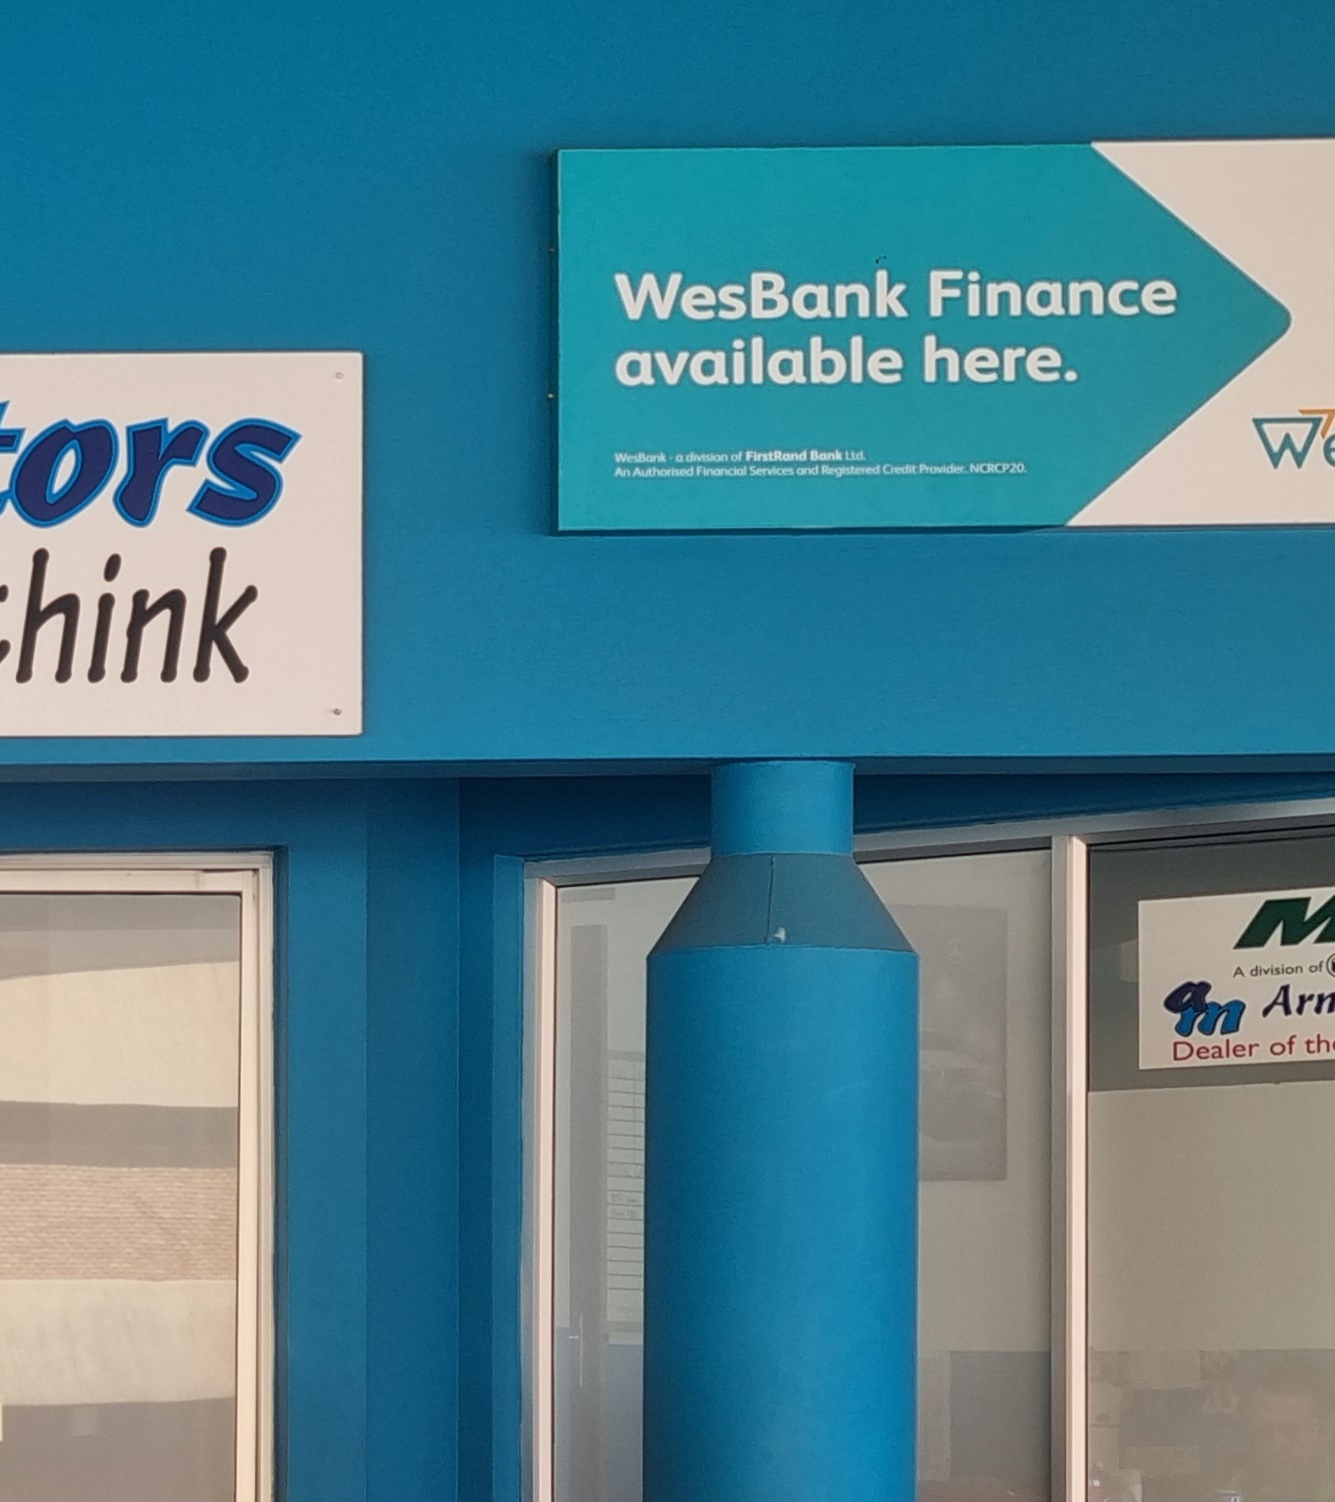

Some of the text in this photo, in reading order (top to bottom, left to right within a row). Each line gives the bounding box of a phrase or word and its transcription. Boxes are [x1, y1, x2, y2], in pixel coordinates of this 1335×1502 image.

[614, 269, 1177, 320] WesBank Finance
[615, 335, 1077, 386] available here.
[615, 453, 666, 463] WesBank
[686, 452, 728, 462] division
[731, 451, 743, 462] of
[746, 451, 807, 462] FirstRand
[810, 450, 843, 461] Bank
[845, 450, 866, 461] Ltd.
[615, 463, 1027, 478] An Authorised Financial Services and Registered Credit Provider. NCRCP20.
[1233, 961, 1324, 978] A division of
[1172, 1033, 1335, 1061] Dealer of th
